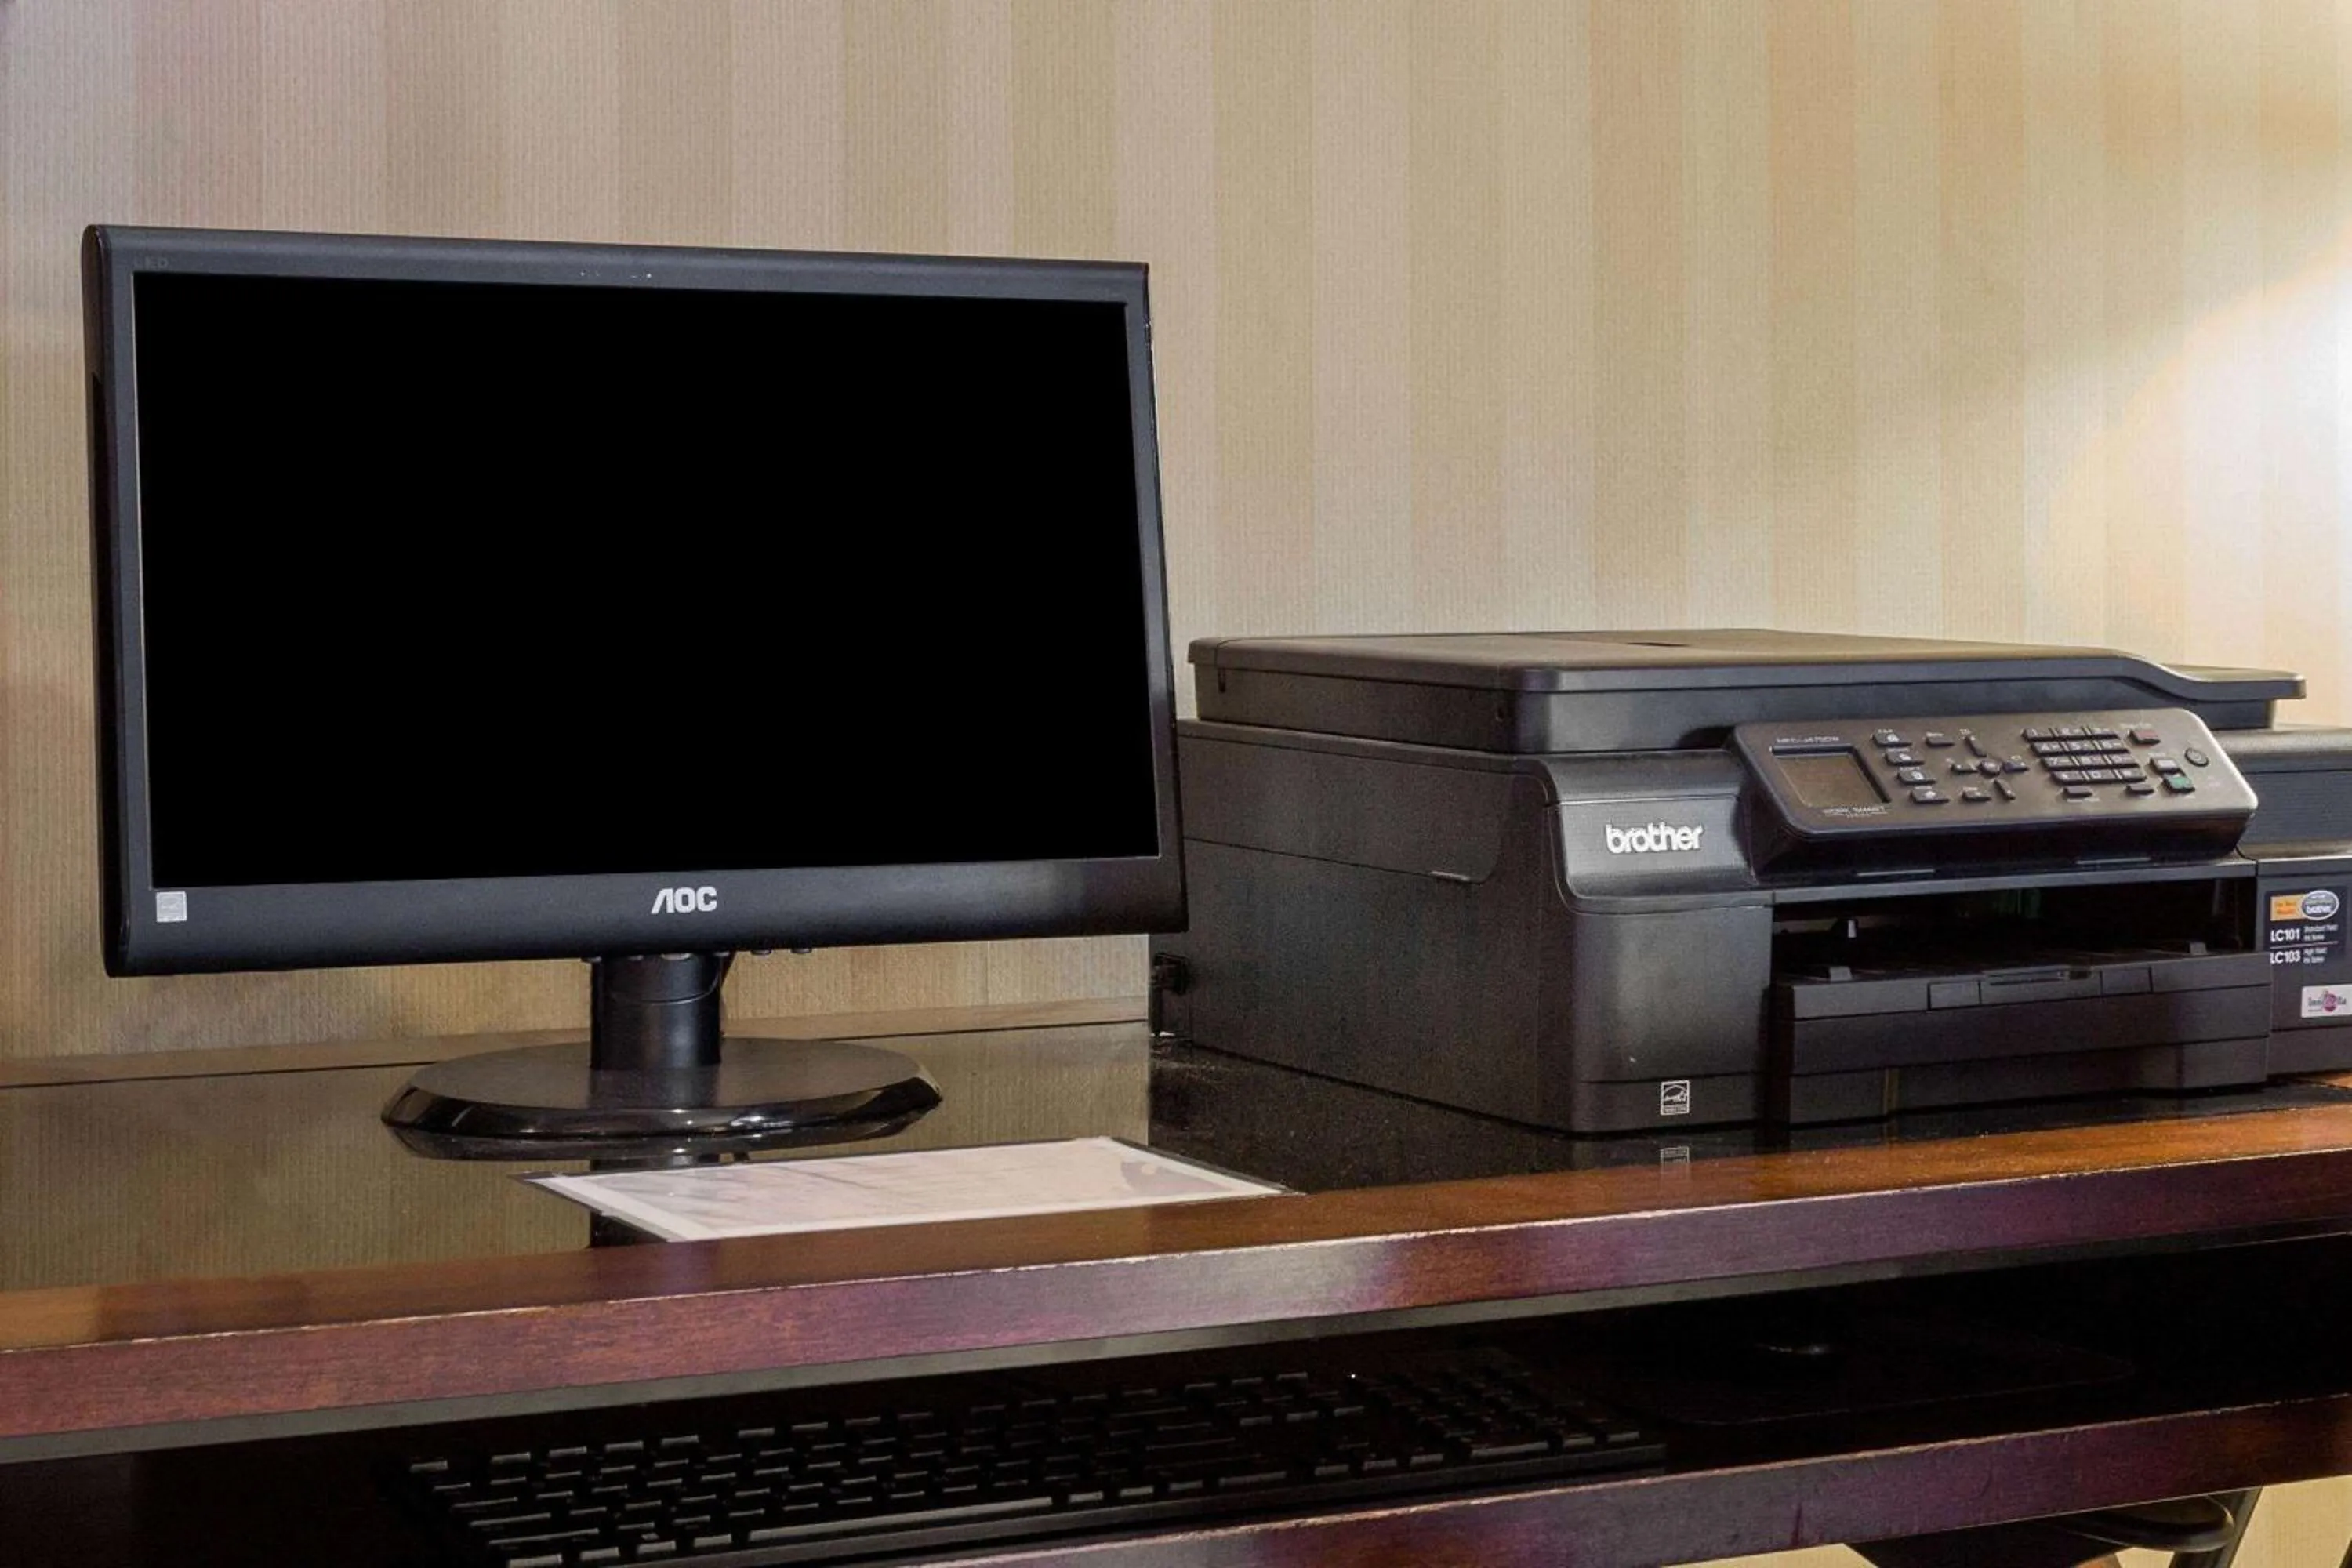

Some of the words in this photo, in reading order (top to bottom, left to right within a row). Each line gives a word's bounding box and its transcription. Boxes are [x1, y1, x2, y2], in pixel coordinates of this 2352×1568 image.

[1605, 822, 1704, 853] brother
[651, 886, 717, 915] AOC
[2270, 927, 2301, 942] LC101
[2270, 949, 2301, 964] LC103
